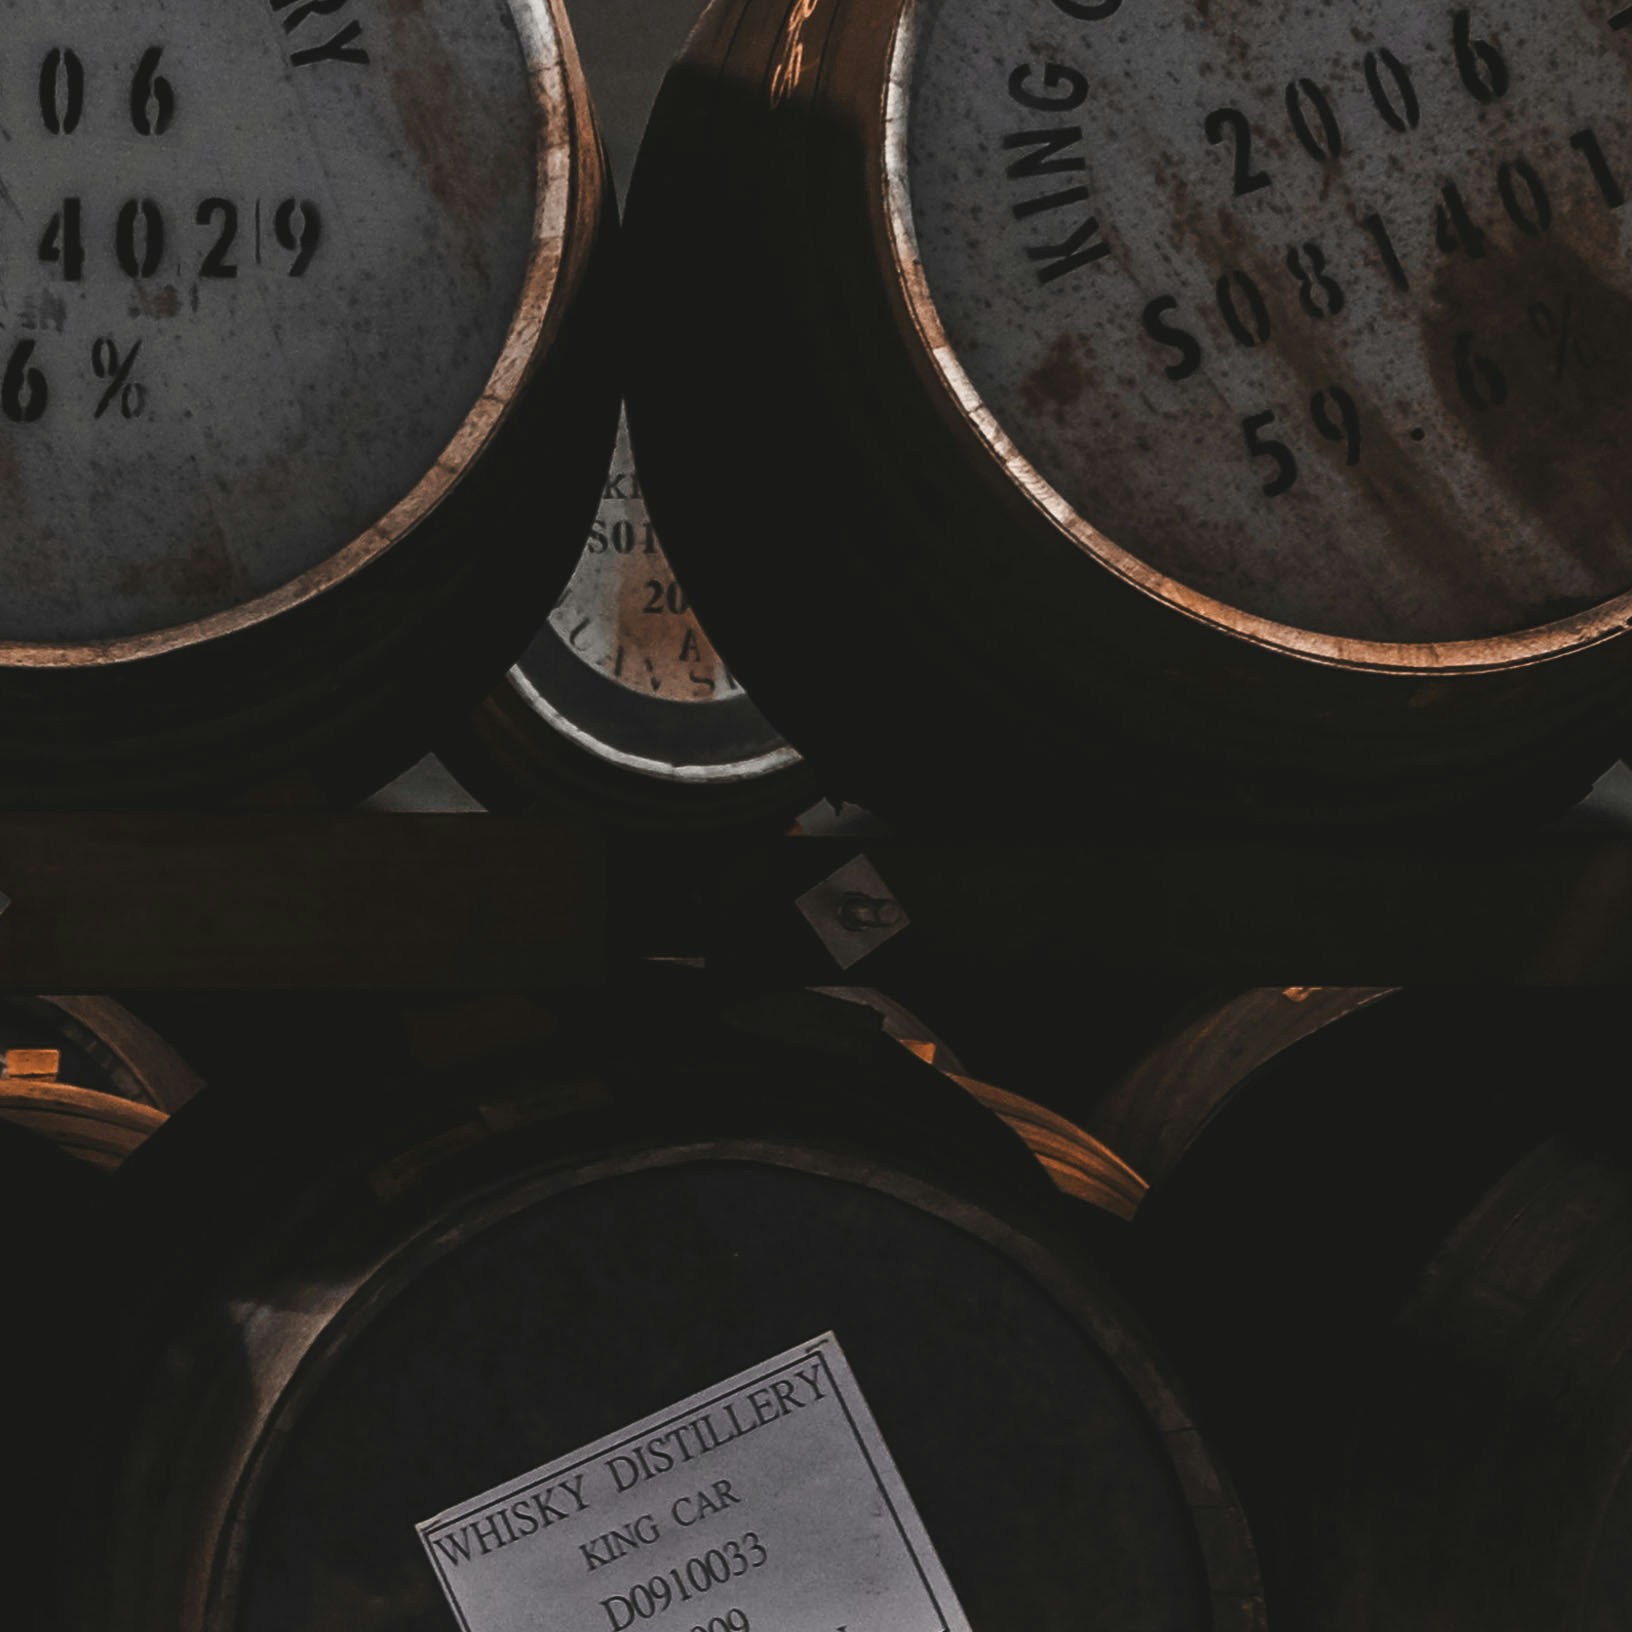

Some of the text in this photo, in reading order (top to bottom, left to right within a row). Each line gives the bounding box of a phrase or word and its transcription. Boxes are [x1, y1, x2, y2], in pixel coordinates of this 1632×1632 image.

[1003, 61, 1111, 284] KING
[1204, 9, 1510, 196] 2006
[678, 628, 701, 662] A
[434, 1362, 827, 1569] WHISKY DISTILLERY
[579, 1479, 741, 1572] KING CAR
